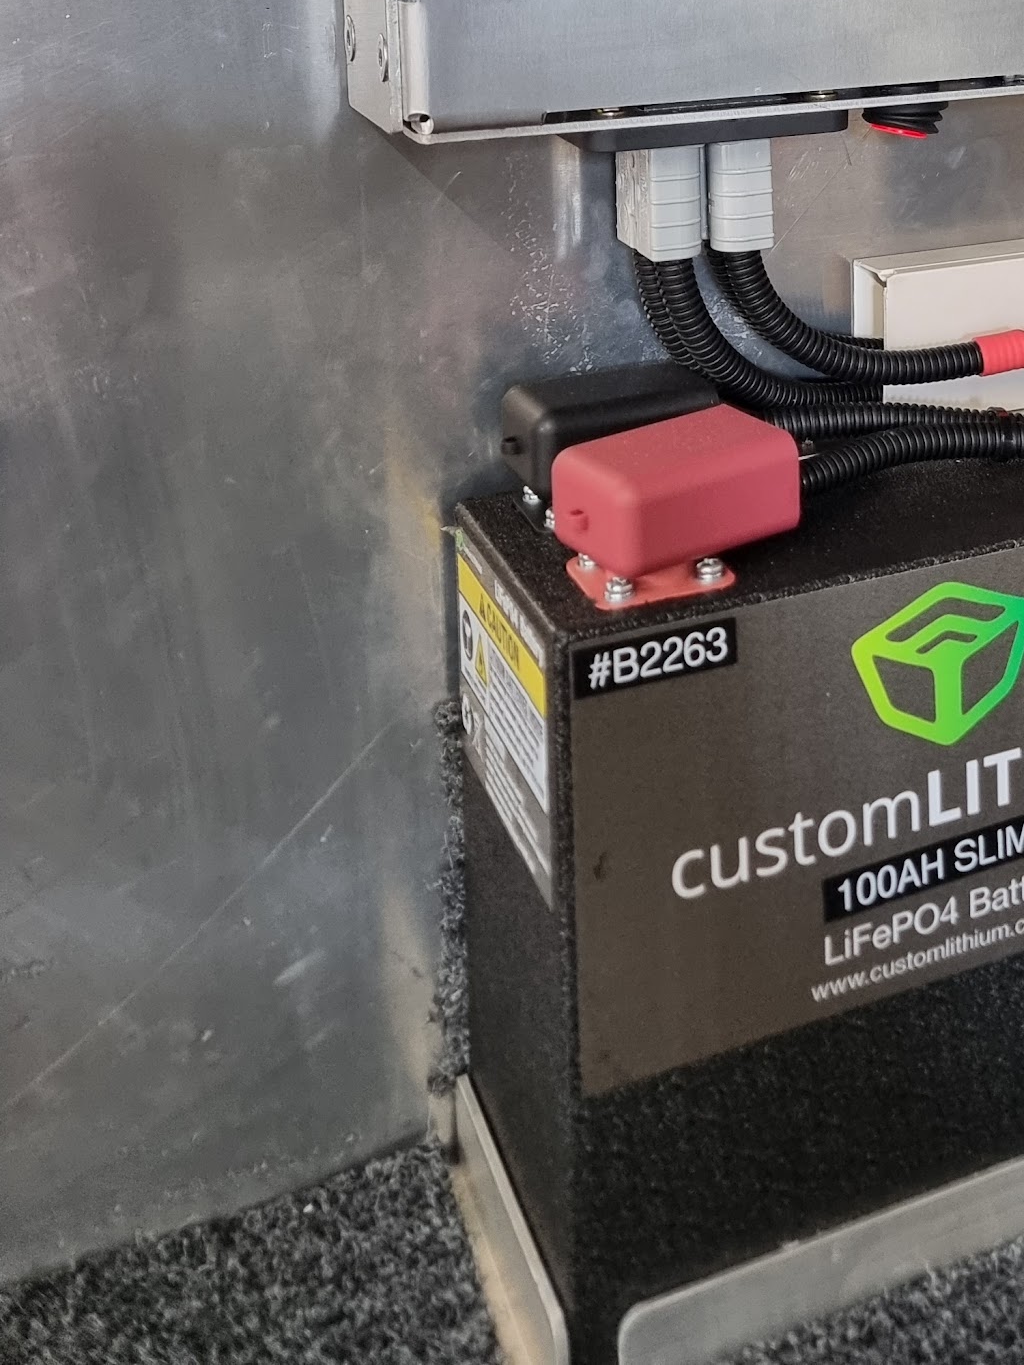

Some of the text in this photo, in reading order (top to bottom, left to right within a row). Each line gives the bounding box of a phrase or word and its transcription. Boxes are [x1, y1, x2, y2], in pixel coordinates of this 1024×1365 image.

[486, 602, 520, 672] CAUTION
[588, 625, 729, 689] #B2263
[838, 848, 945, 912] 100AH
[824, 896, 960, 966] LiFePO4
